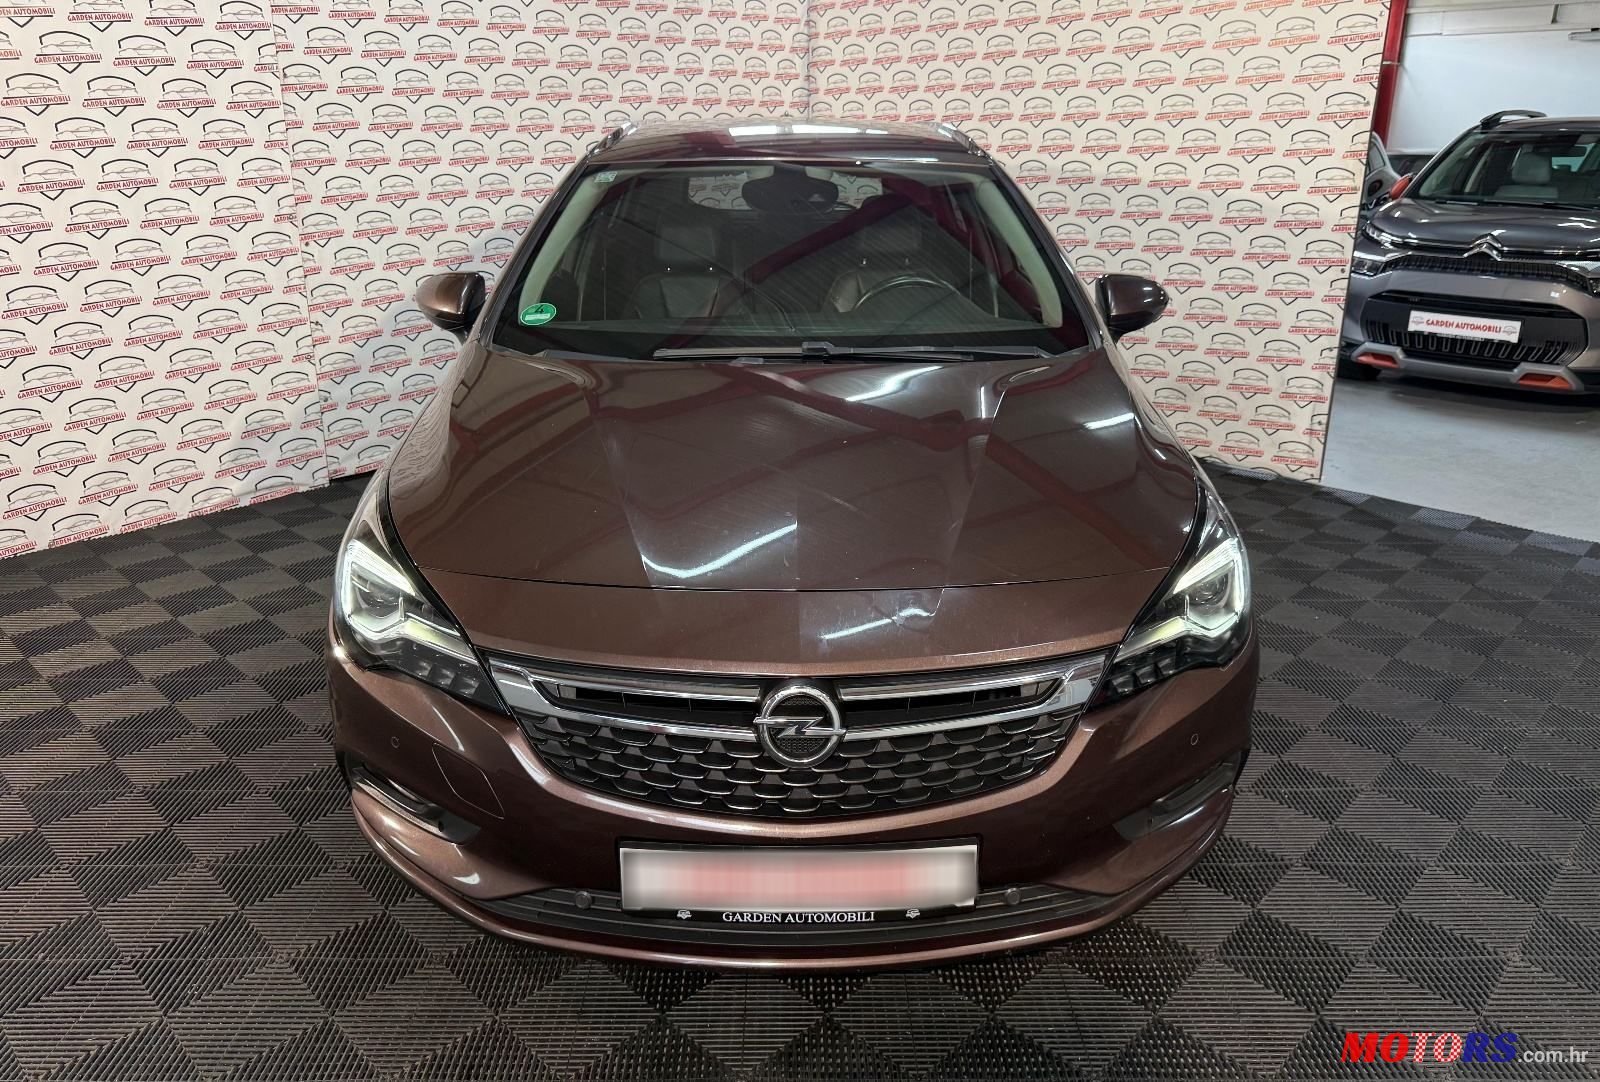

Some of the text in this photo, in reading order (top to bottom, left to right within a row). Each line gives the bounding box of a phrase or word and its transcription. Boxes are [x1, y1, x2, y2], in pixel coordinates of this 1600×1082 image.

[1349, 31, 1383, 42] AUTOMOBILI
[34, 53, 102, 64] GARDEN AUTOMOBILI
[113, 57, 176, 67] GARDEN AUTOMOBILI
[210, 60, 244, 68] AUTOMOBILI
[1313, 72, 1345, 81] AUTOMOBILI
[356, 85, 384, 93] AUTOMOBILI
[0, 95, 71, 107] GARDEN AUTOMOBILI
[82, 97, 146, 108] GARDEN AUTOMOBILI
[182, 98, 217, 107] AUTOMOBILI
[249, 100, 282, 108] AUTOMOBILI
[1279, 110, 1309, 119] AUTOMOBILI
[1338, 110, 1371, 119] AUTOMOBILI
[332, 121, 360, 129] AUTOMOBILI
[387, 121, 414, 130] AUTOMOBILI
[50, 137, 116, 150] GARDEN AUTOMOBILI
[126, 138, 188, 150] GARDEN AUTOMOBILI
[221, 138, 255, 147] AUTOMOBILI
[1246, 146, 1276, 154] AUTOMOBILI
[1303, 148, 1335, 156] AUTOMOBILI
[345, 157, 391, 168] GARDEN AUTOMOBILI
[17, 179, 86, 193] GARDEN AUTOMOBILI
[96, 177, 159, 191] GARDEN AUTOMOBILI
[169, 176, 228, 189] GARDEN AUTOMOBILI
[237, 175, 291, 187] GARDEN AUTOMOBILI
[1270, 183, 1300, 191] AUTOMOBILI
[320, 192, 369, 205] GARDEN AUTOMOBILI
[376, 191, 420, 203] GARDEN AUTOMOBILI
[65, 218, 130, 233] GARDEN AUTOMOBILI
[139, 215, 200, 229] GARDEN AUTOMOBILI
[209, 213, 265, 226] GARDEN AUTOMOBILI
[181, 251, 238, 266] GARDEN AUTOMOBILI
[247, 247, 300, 261] GARDEN AUTOMOBILI
[33, 260, 100, 276] GARDEN AUTOMOBILI
[110, 255, 171, 271] GARDEN AUTOMOBILI
[330, 261, 375, 276] GARDEN AUTOMOBILI
[152, 290, 211, 306] GARDEN AUTOMOBILI
[220, 285, 274, 300] GARDEN AUTOMOBILI
[1, 302, 69, 320] GARDEN AUTOMOBILI
[79, 296, 142, 313] GARDEN AUTOMOBILI
[193, 323, 248, 340] GARDEN AUTOMOBILI
[257, 317, 308, 333] GARDEN AUTOMOBILI
[1425, 319, 1502, 333] GARDEN AUTOMOBILI
[124, 330, 183, 347] GARDEN AUTOMOBILI
[338, 328, 384, 344] GARDEN AUTOMOBILI
[49, 337, 113, 356] GARDEN AUTOMOBILI
[230, 354, 283, 371] GARDEN AUTOMOBILI
[165, 362, 222, 380] GARDEN AUTOMOBILI
[94, 370, 155, 389] GARDEN AUTOMOBILI
[17, 379, 83, 399] GARDEN AUTOMOBILI
[204, 392, 258, 411] GARDEN AUTOMOBILI
[136, 401, 195, 421] GARDEN AUTOMOBILI
[64, 411, 127, 432] GARDEN AUTOMOBILI
[176, 431, 232, 451] GARDEN AUTOMOBILI
[107, 442, 167, 463] GARDEN AUTOMOBILI
[276, 449, 324, 468] GARDEN AUTOMOBILI
[32, 453, 97, 475] GARDEN AUTOMOBILI
[148, 471, 205, 492] GARDEN AUTOMOBILI
[78, 483, 139, 505] GARDEN AUTOMOBILI
[2, 496, 67, 520] GARDEN AUTOMOBILI
[722, 911, 875, 923] GARDEN AUTOMOBILI
